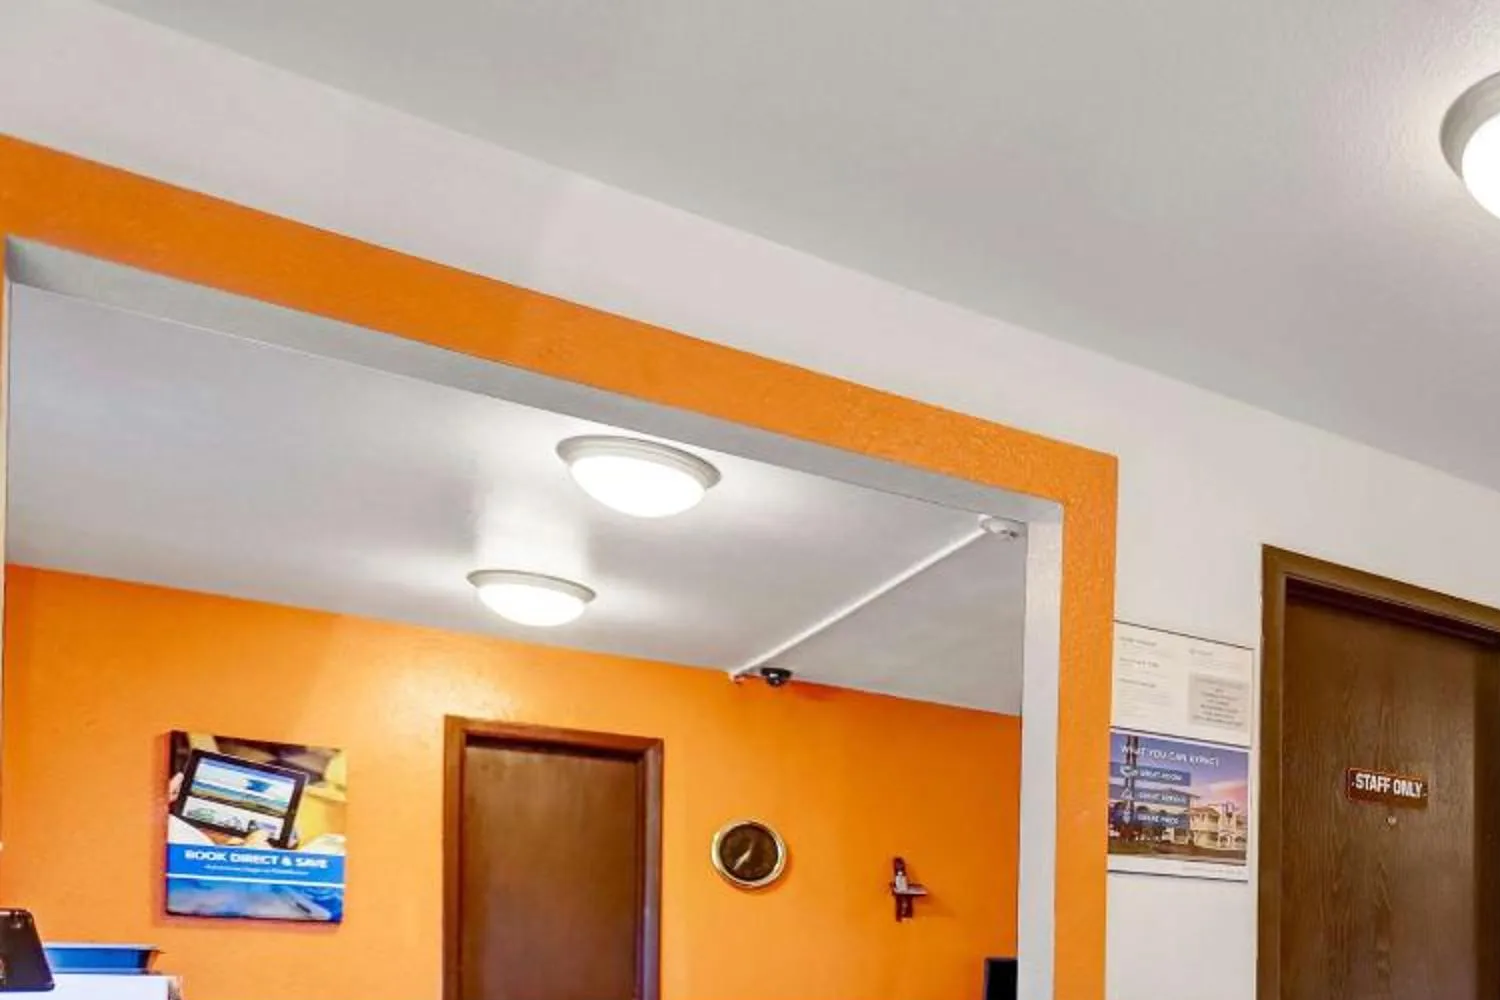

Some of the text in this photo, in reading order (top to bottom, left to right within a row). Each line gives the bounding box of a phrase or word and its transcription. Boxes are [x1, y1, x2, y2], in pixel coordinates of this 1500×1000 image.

[1355, 772, 1423, 799] STAFF ONLY
[184, 849, 328, 868] BOOK DIRECT & SAVE
